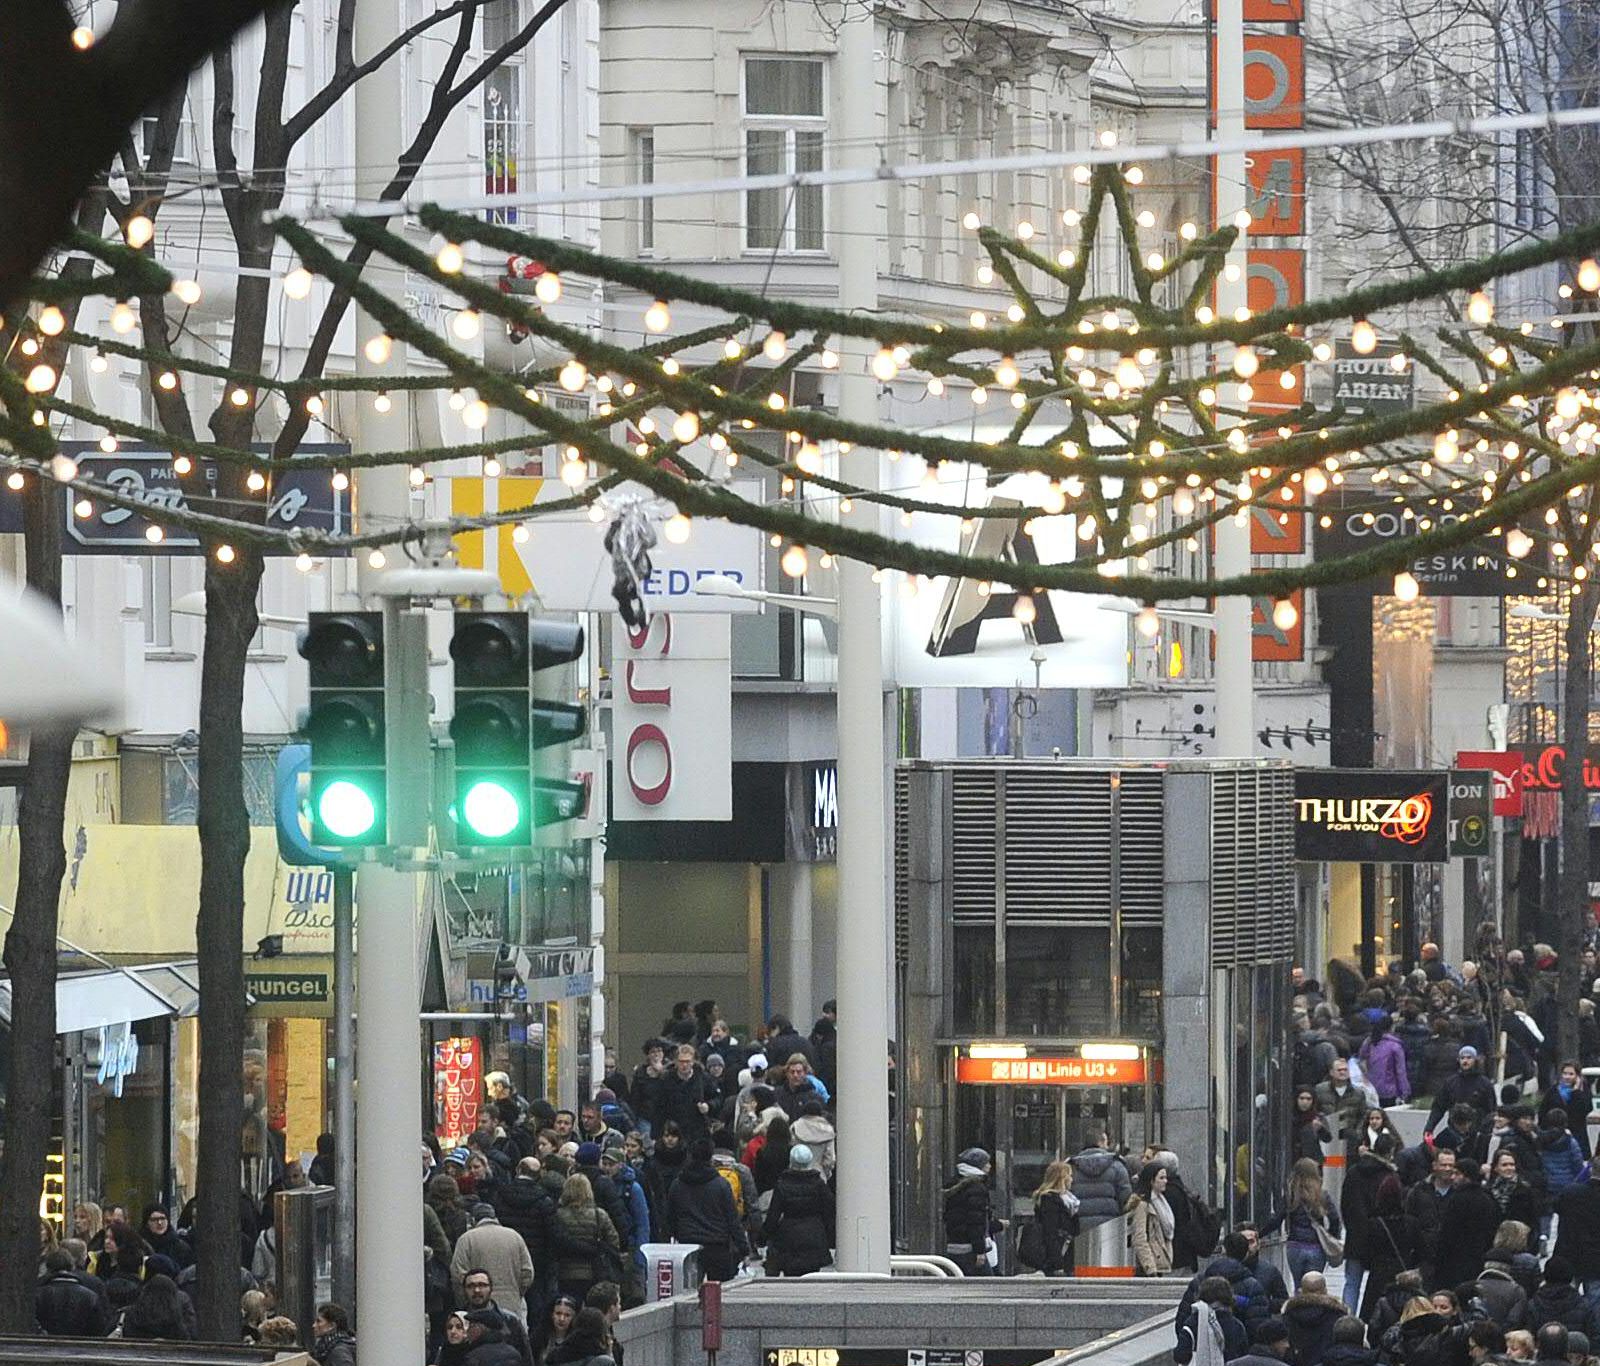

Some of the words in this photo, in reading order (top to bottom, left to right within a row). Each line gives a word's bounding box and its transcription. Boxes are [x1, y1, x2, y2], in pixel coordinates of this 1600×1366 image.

[1294, 798, 1425, 823] THURZO
[1326, 823, 1351, 832] FOR
[1354, 823, 1380, 832] YOU
[1047, 1062, 1082, 1077] Linie
[1085, 1062, 1105, 1077] U3
